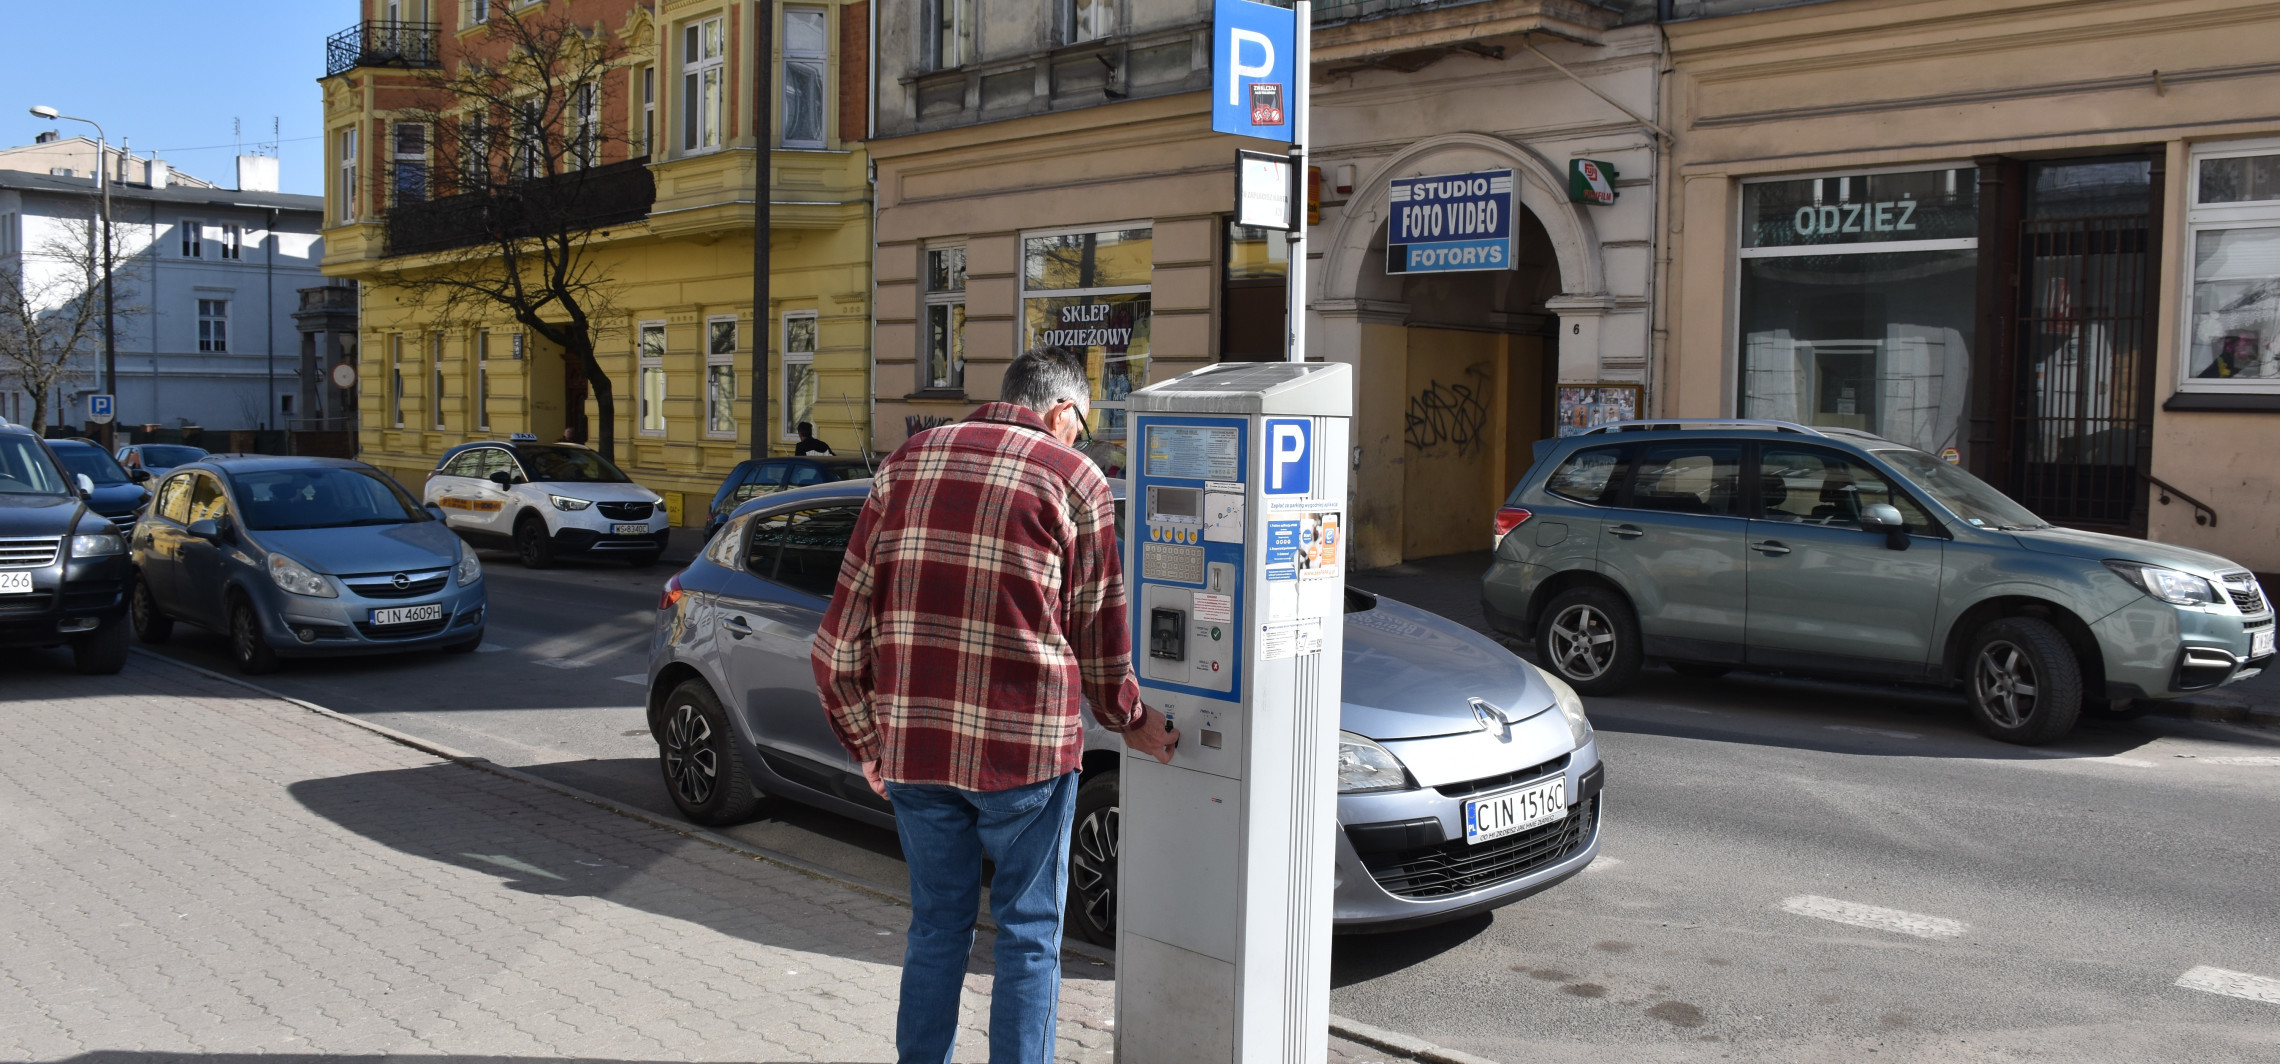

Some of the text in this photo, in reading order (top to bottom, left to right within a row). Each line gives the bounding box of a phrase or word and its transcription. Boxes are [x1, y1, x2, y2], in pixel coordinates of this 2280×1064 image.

[1229, 27, 1275, 106] P
[1413, 178, 1488, 201] STUDIO
[1583, 189, 1612, 200] FUJIFILM
[1401, 199, 1498, 238] FOTO VIDEO
[1795, 192, 1917, 236] ODZIEŻ
[1410, 245, 1502, 267] FOTORYS
[1062, 304, 1110, 323] SKLEP
[1043, 325, 1132, 346] ODZIEŻOWY
[1573, 323, 1580, 335] 6
[95, 398, 107, 412] P
[1272, 424, 1305, 490] P
[376, 606, 440, 624] CIN 4609H
[1468, 783, 1563, 832] PL CIN 1516C
